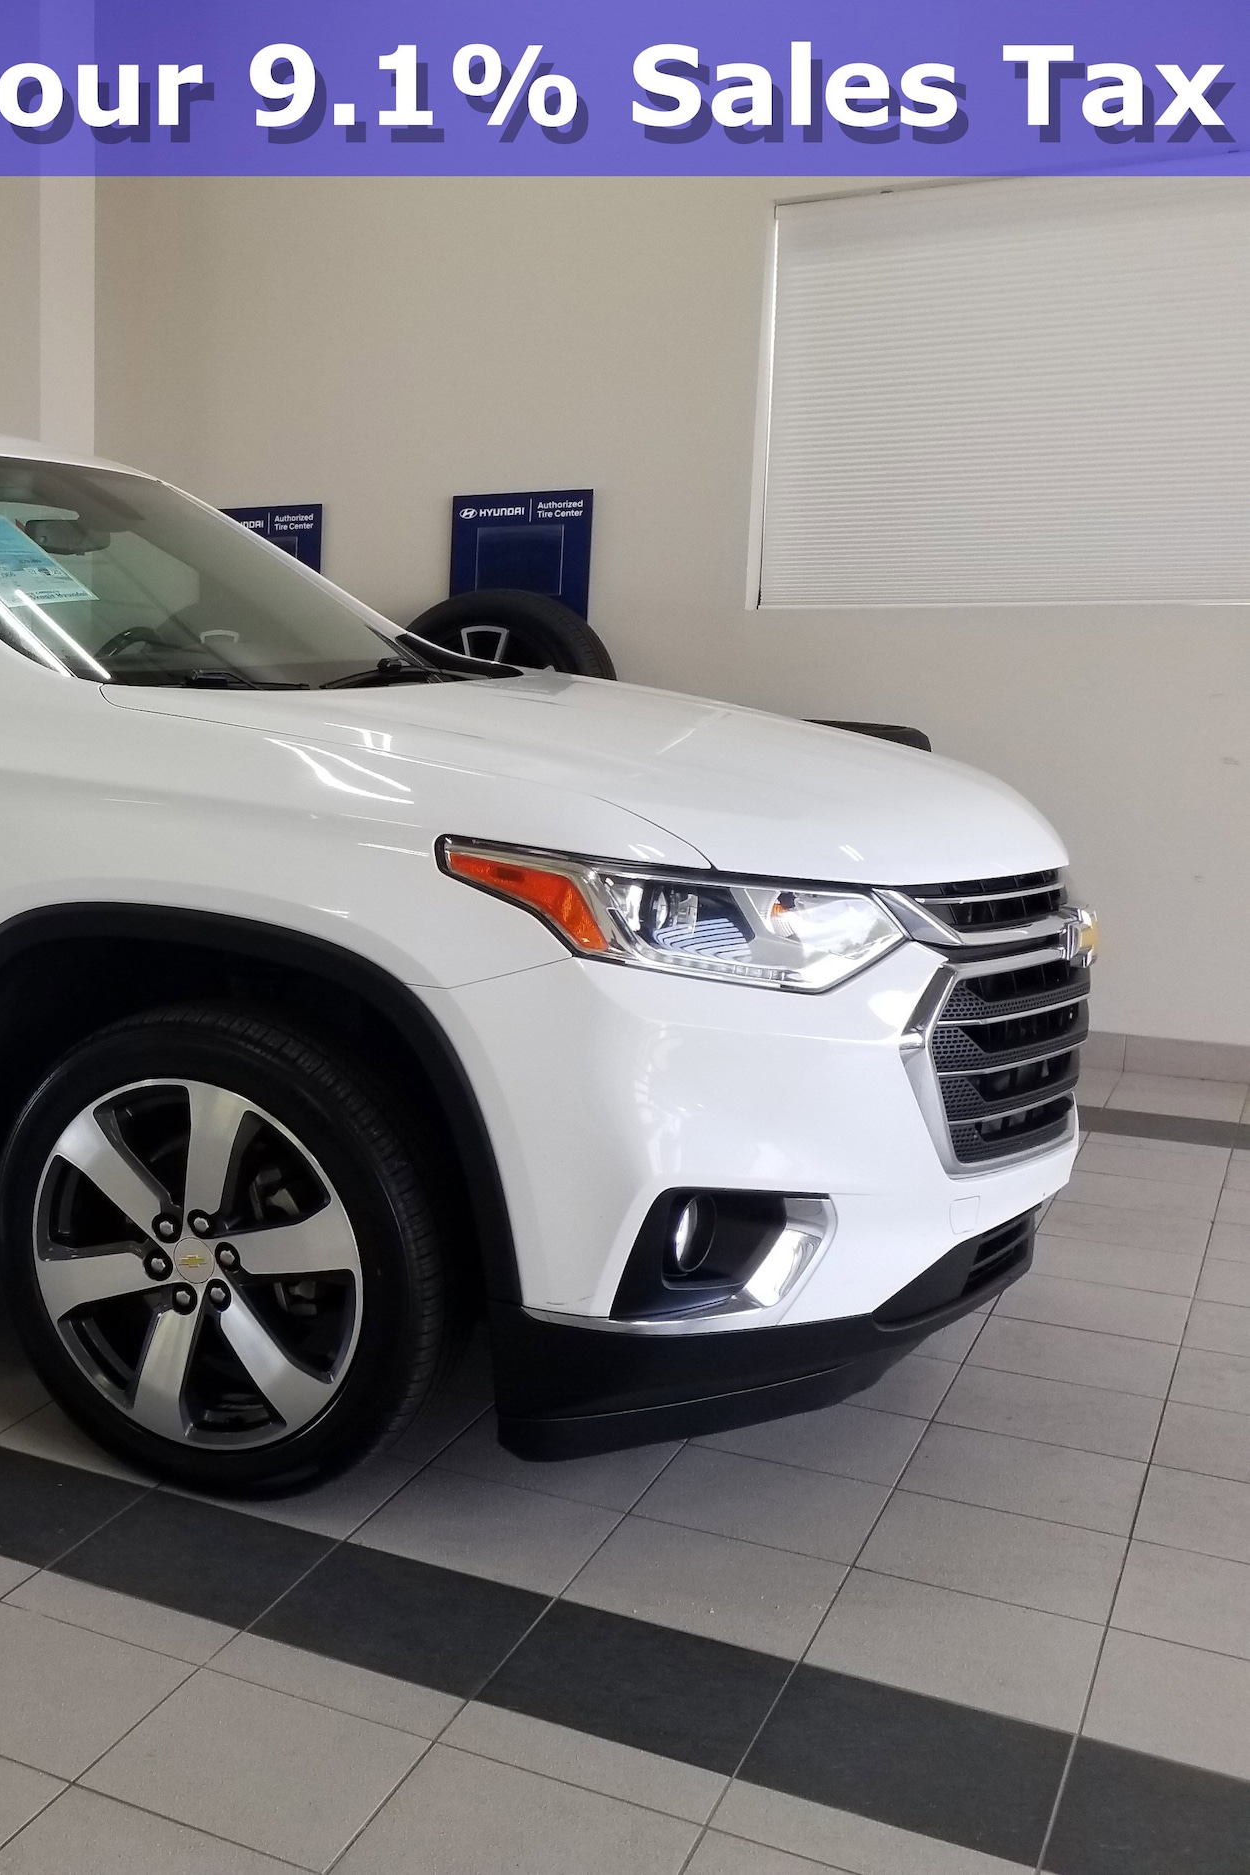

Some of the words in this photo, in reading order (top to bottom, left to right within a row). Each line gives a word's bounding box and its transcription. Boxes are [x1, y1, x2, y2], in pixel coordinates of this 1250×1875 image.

[537, 500, 584, 509] Authorized
[479, 507, 525, 517] HYUNDAI
[537, 510, 553, 518] Tire
[554, 509, 584, 518] Center
[274, 513, 314, 522] Authorized
[274, 523, 288, 531] Tire
[289, 522, 314, 530] Center
